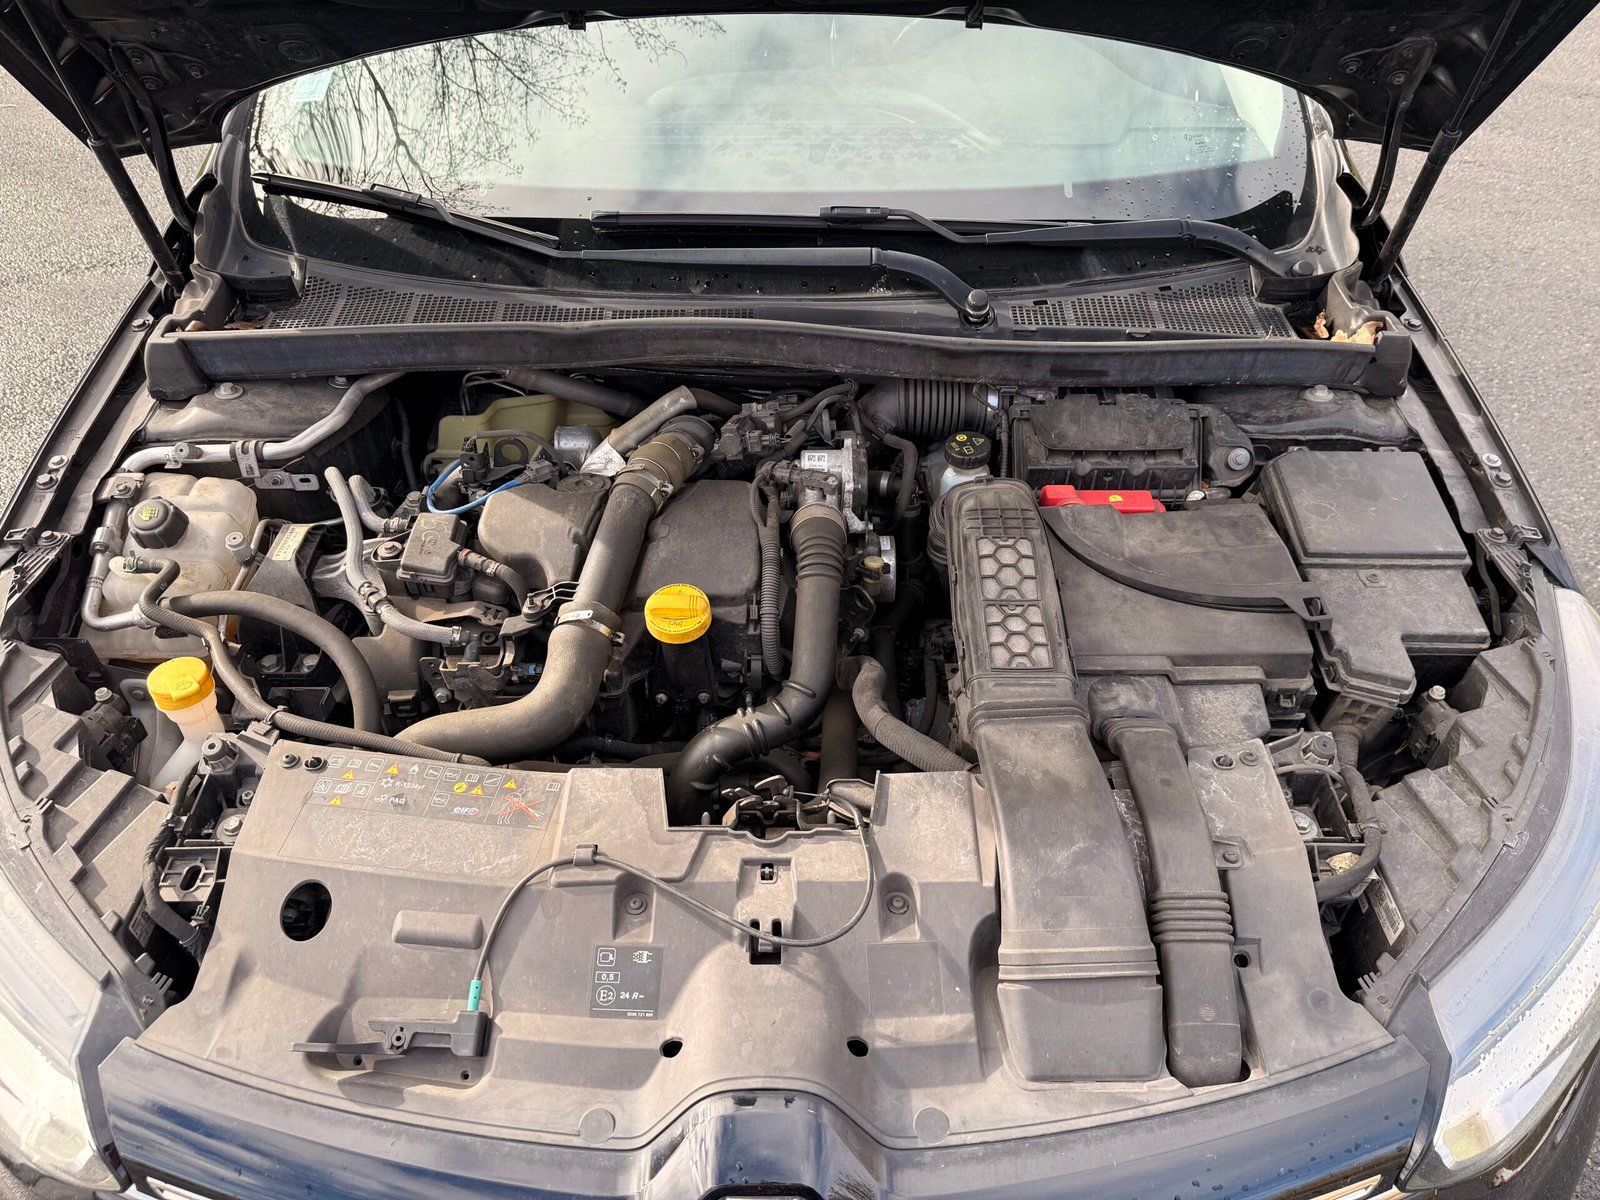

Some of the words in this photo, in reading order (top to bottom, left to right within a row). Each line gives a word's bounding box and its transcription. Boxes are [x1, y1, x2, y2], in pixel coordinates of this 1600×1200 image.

[394, 781, 426, 790] R-1234yf
[389, 796, 406, 804] PAG
[452, 805, 472, 815] elf
[601, 973, 614, 982] 0,5
[599, 990, 614, 1002] E2
[619, 991, 630, 999] 24
